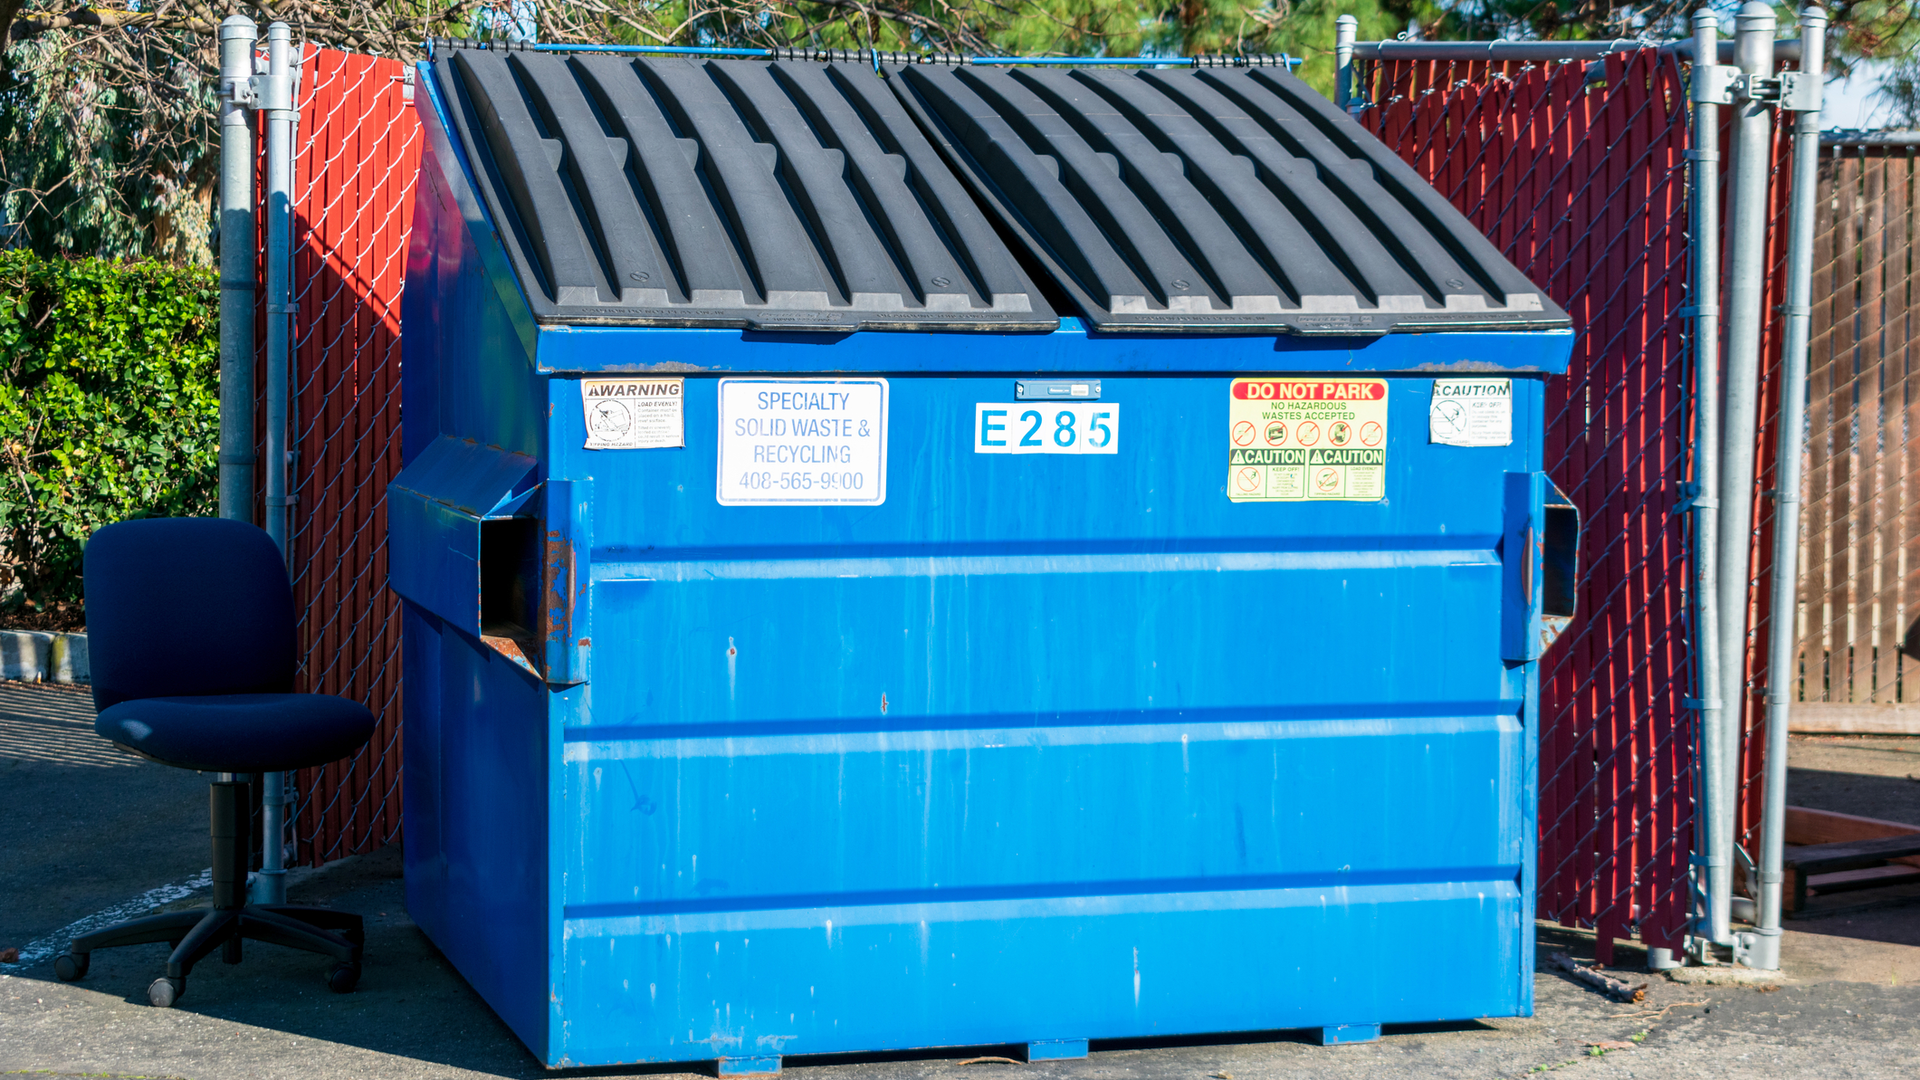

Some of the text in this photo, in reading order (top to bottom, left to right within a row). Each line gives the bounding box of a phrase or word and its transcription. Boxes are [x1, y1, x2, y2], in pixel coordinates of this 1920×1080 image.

[600, 384, 679, 396] WARNING
[1247, 384, 1374, 399] DO NOT PARK
[1442, 385, 1507, 396] CAUTION
[758, 391, 850, 410] SPECIALTY
[1271, 402, 1347, 410] NO HAZARDOUS
[1262, 412, 1356, 420] WASTES ACCEPTED
[735, 418, 870, 437] SOLID WASTE &
[754, 445, 851, 463] RECYCLING
[1245, 450, 1304, 464] CAUTION
[1324, 450, 1382, 464] CAUTION
[739, 471, 864, 490] 408-565-9900
